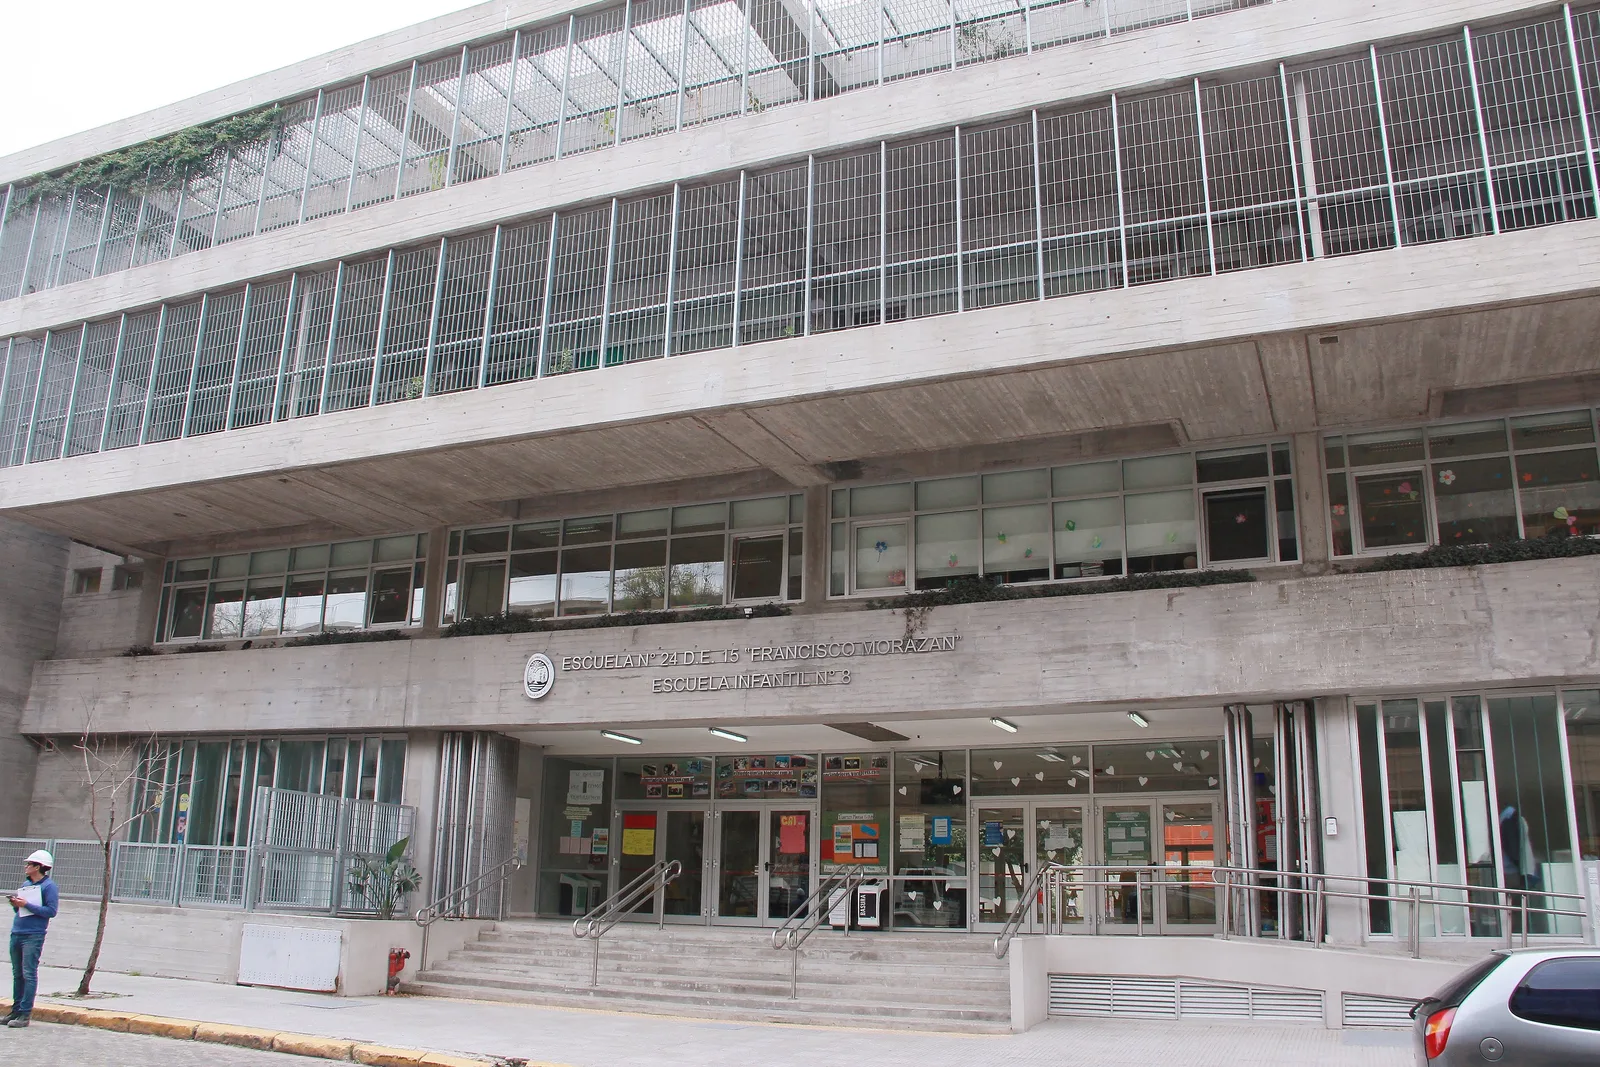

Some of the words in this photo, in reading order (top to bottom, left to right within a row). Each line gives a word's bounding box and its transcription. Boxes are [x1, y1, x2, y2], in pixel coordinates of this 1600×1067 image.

[562, 654, 634, 671] ESCUELA
[638, 652, 655, 667] N°
[660, 651, 678, 666] 24
[683, 649, 715, 665] D.E.
[722, 648, 739, 663] 15
[652, 675, 730, 693] ESCUELA
[734, 671, 811, 690] INFANTIL
[815, 669, 836, 686] N°
[841, 668, 851, 684] 8
